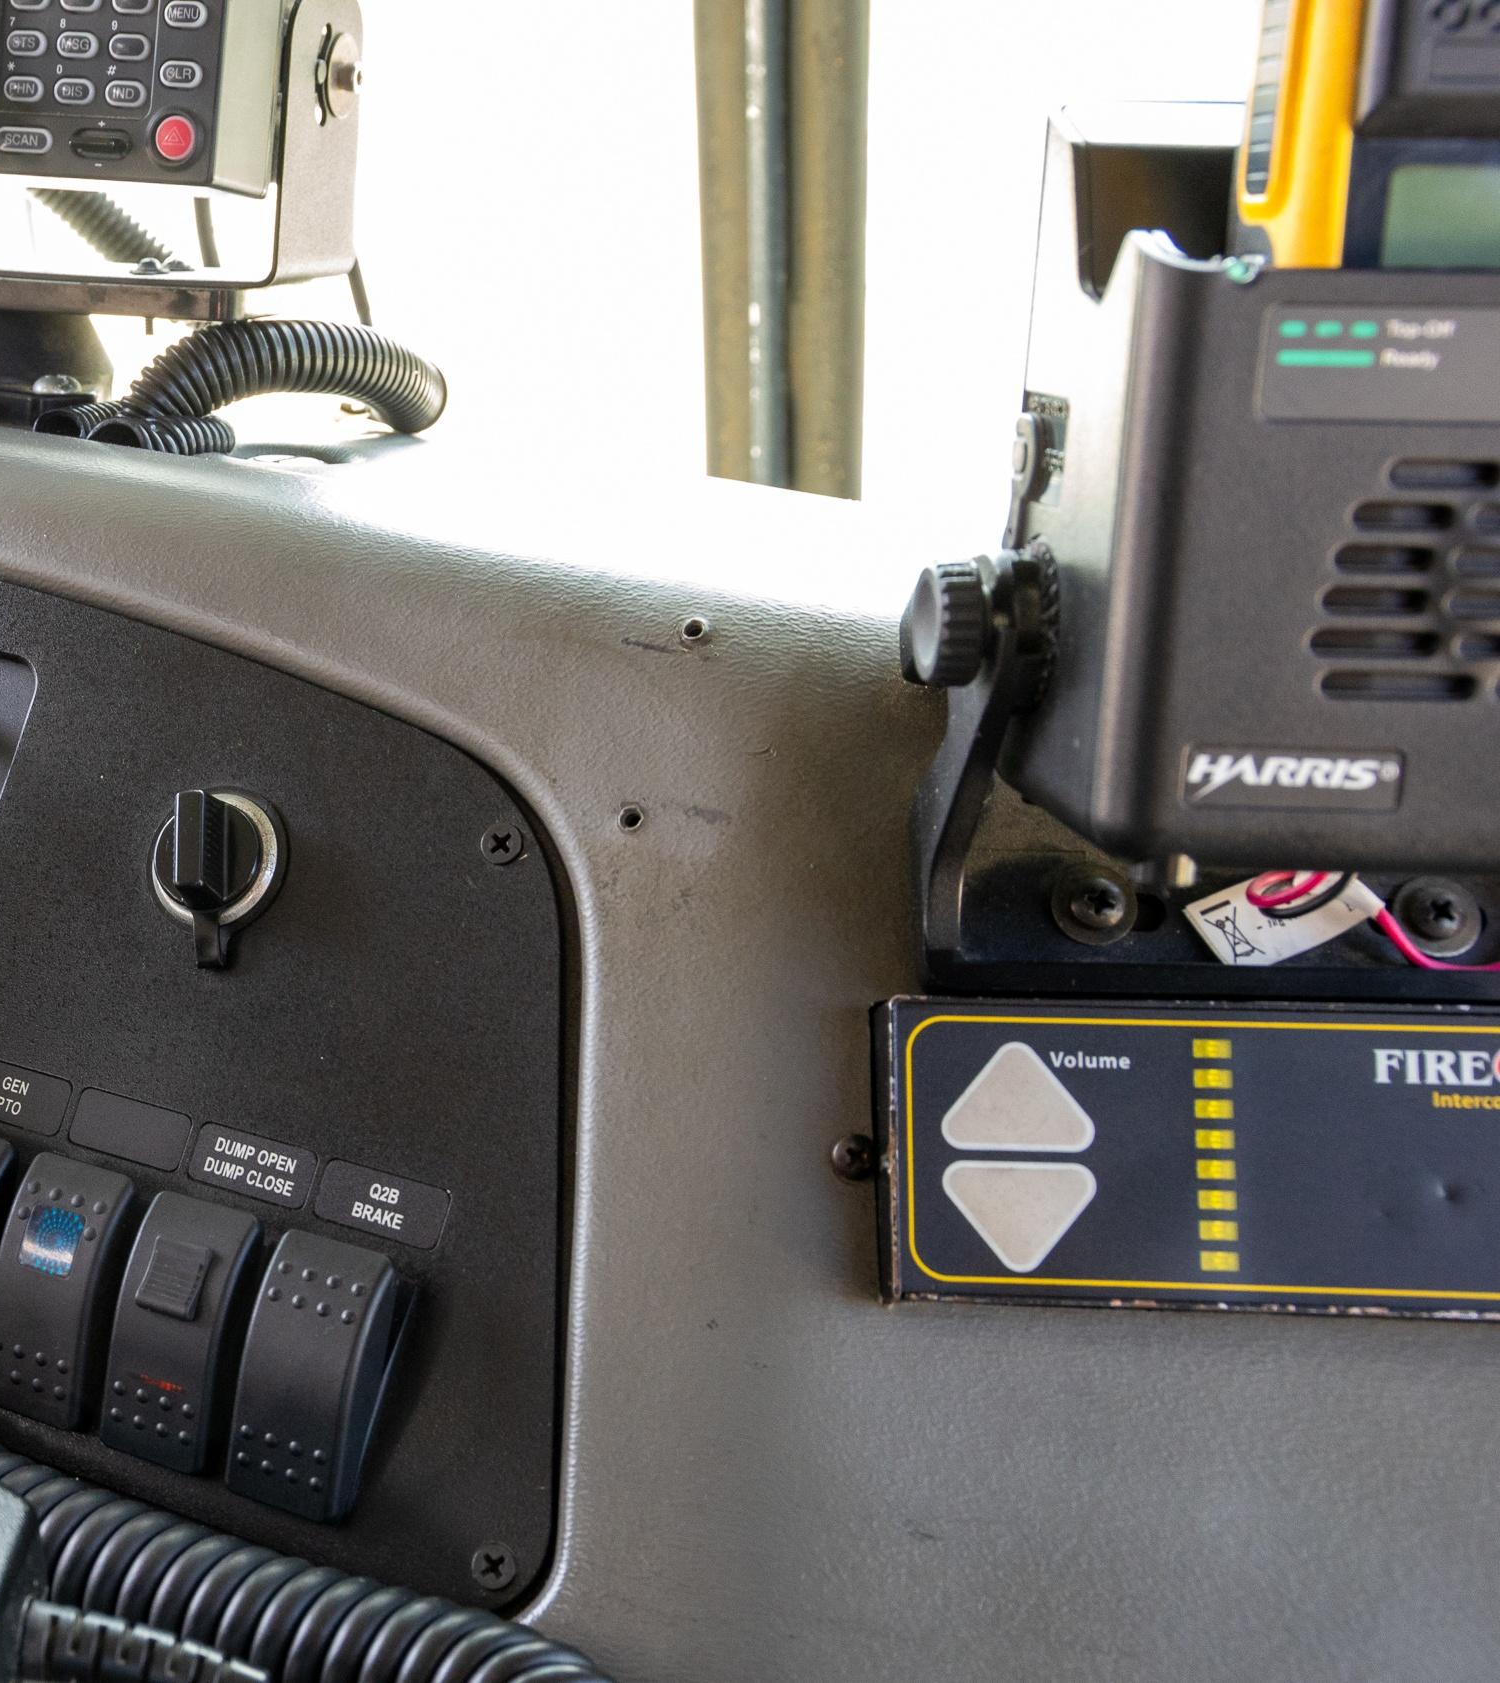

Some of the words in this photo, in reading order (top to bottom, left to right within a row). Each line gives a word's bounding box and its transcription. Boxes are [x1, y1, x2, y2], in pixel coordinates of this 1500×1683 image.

[168, 7, 199, 20] MENU
[60, 18, 66, 28] 8
[112, 20, 118, 30] 9
[12, 36, 36, 48] STS
[61, 38, 90, 50] MSG
[9, 82, 35, 95] PHN
[4, 134, 38, 147] SCAN
[1187, 754, 1381, 800] HARRIS
[1050, 1051, 1131, 1069] Volume
[2, 1077, 30, 1096] GEN
[214, 1137, 255, 1161] DUMP
[257, 1150, 297, 1174] OPEN
[203, 1157, 244, 1179] DUMP
[246, 1170, 295, 1197] CLOSE
[369, 1183, 400, 1205] Q2B
[352, 1201, 404, 1230] BRAKE
